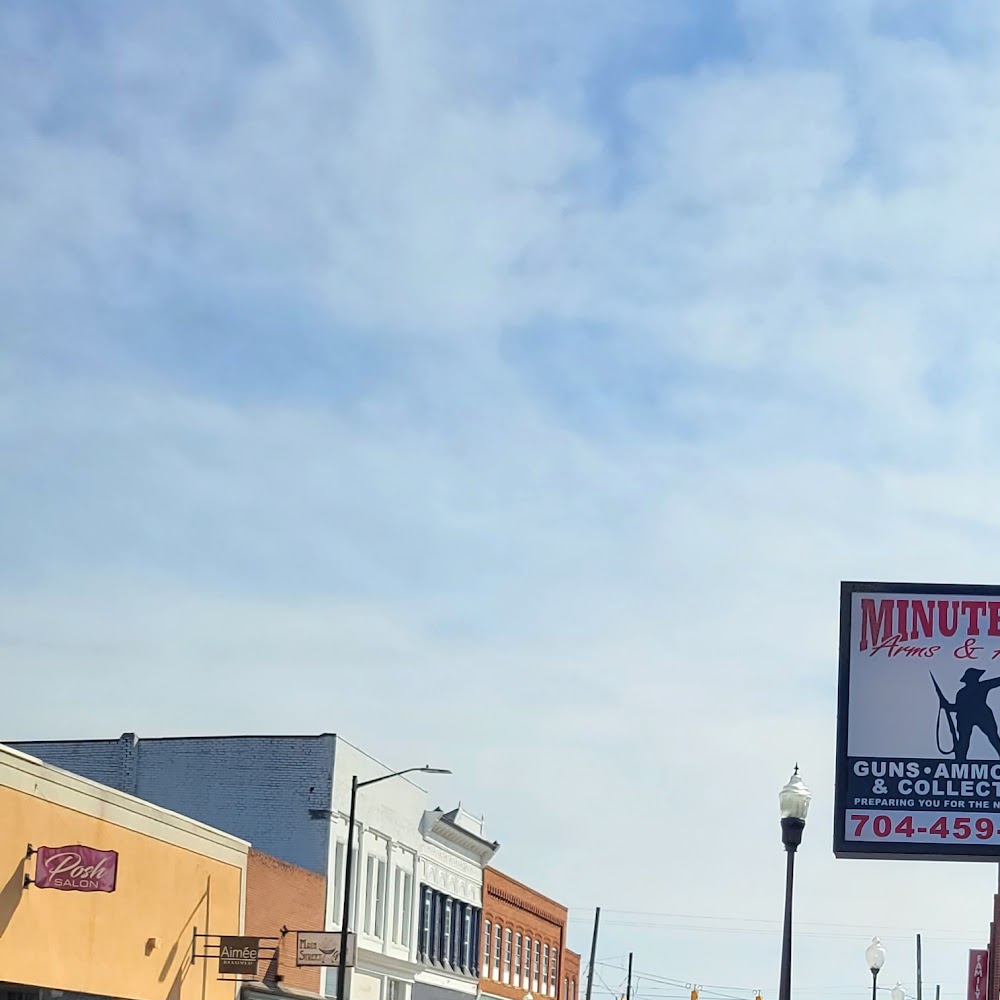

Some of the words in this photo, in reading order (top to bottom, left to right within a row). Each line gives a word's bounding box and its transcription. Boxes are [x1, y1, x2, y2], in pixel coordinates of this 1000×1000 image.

[869, 634, 941, 659] Arms
[953, 638, 984, 659] &
[853, 760, 920, 778] GUNS
[872, 778, 889, 795] &
[854, 797, 915, 807] PREPARING
[918, 798, 941, 808] YOU
[944, 799, 965, 808] FOR
[968, 800, 989, 809] THE
[45, 852, 109, 883] Posh
[54, 878, 99, 889] SALON
[221, 946, 257, 959] Aimée
[974, 954, 982, 999] FAMILY
